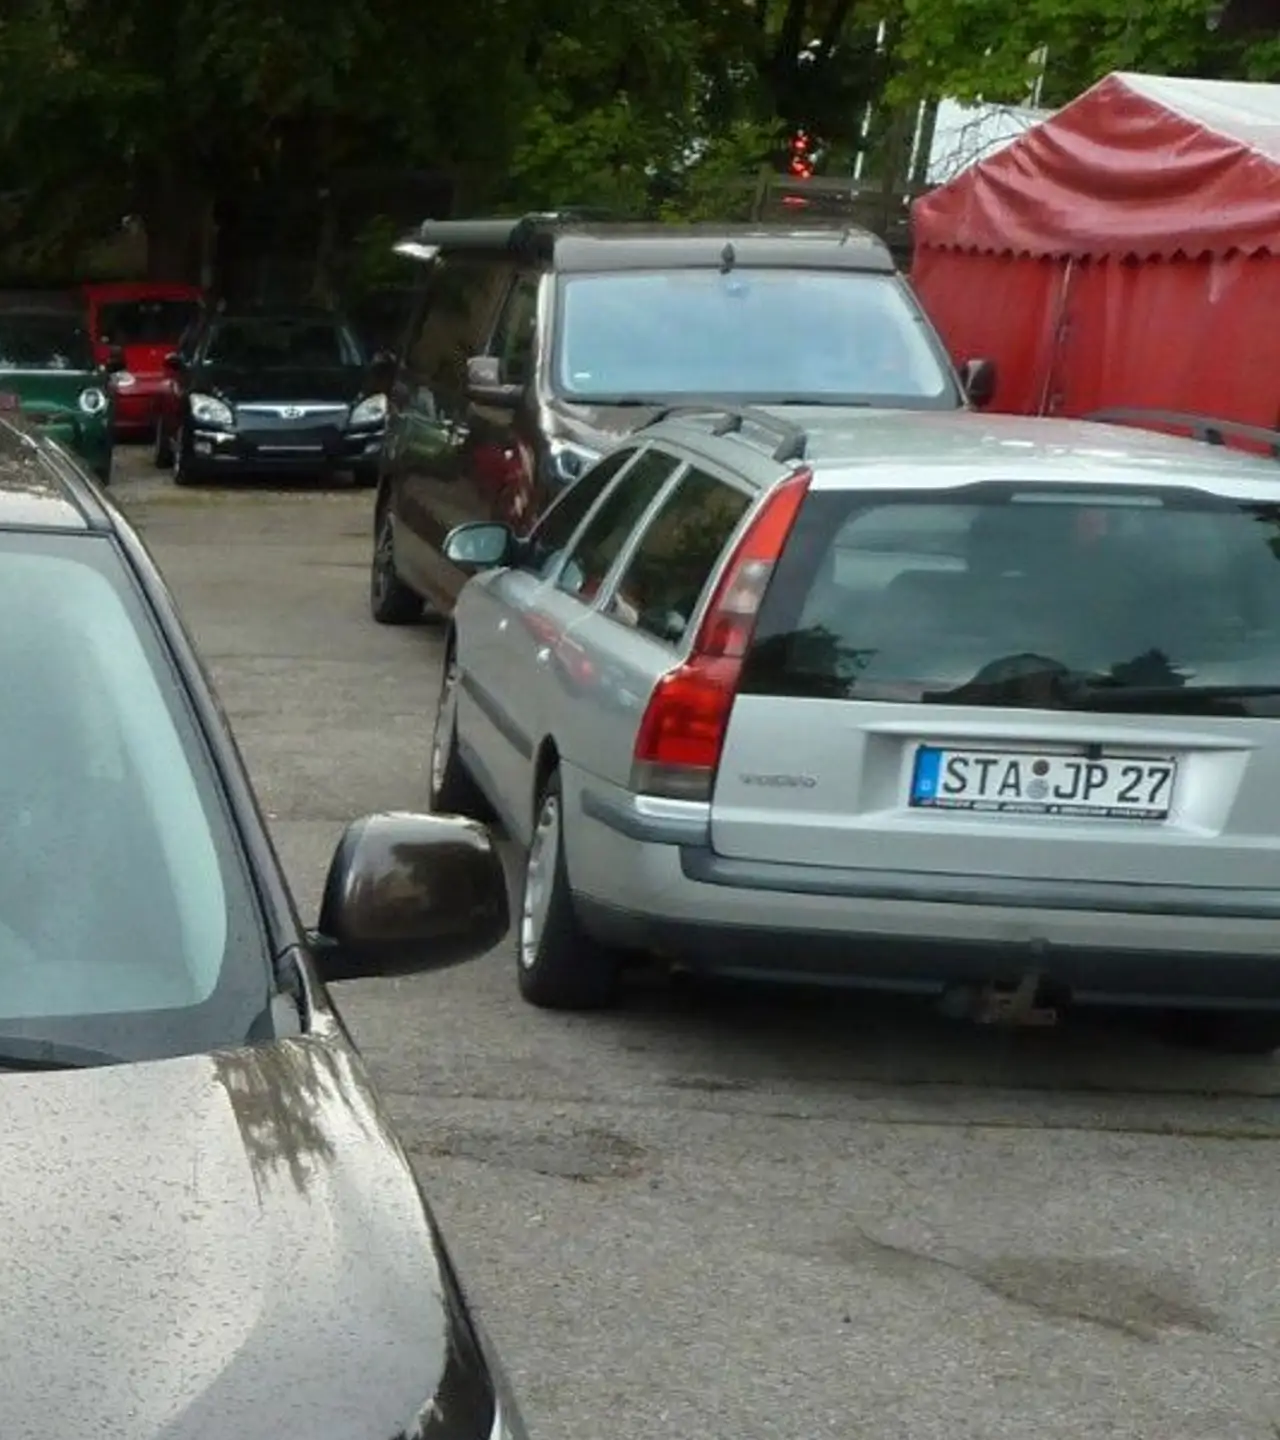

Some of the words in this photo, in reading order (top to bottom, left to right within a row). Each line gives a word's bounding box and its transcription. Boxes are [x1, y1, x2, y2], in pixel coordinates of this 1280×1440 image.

[942, 756, 1022, 798] STA
[1053, 762, 1109, 801] JP
[1116, 766, 1172, 804] 27
